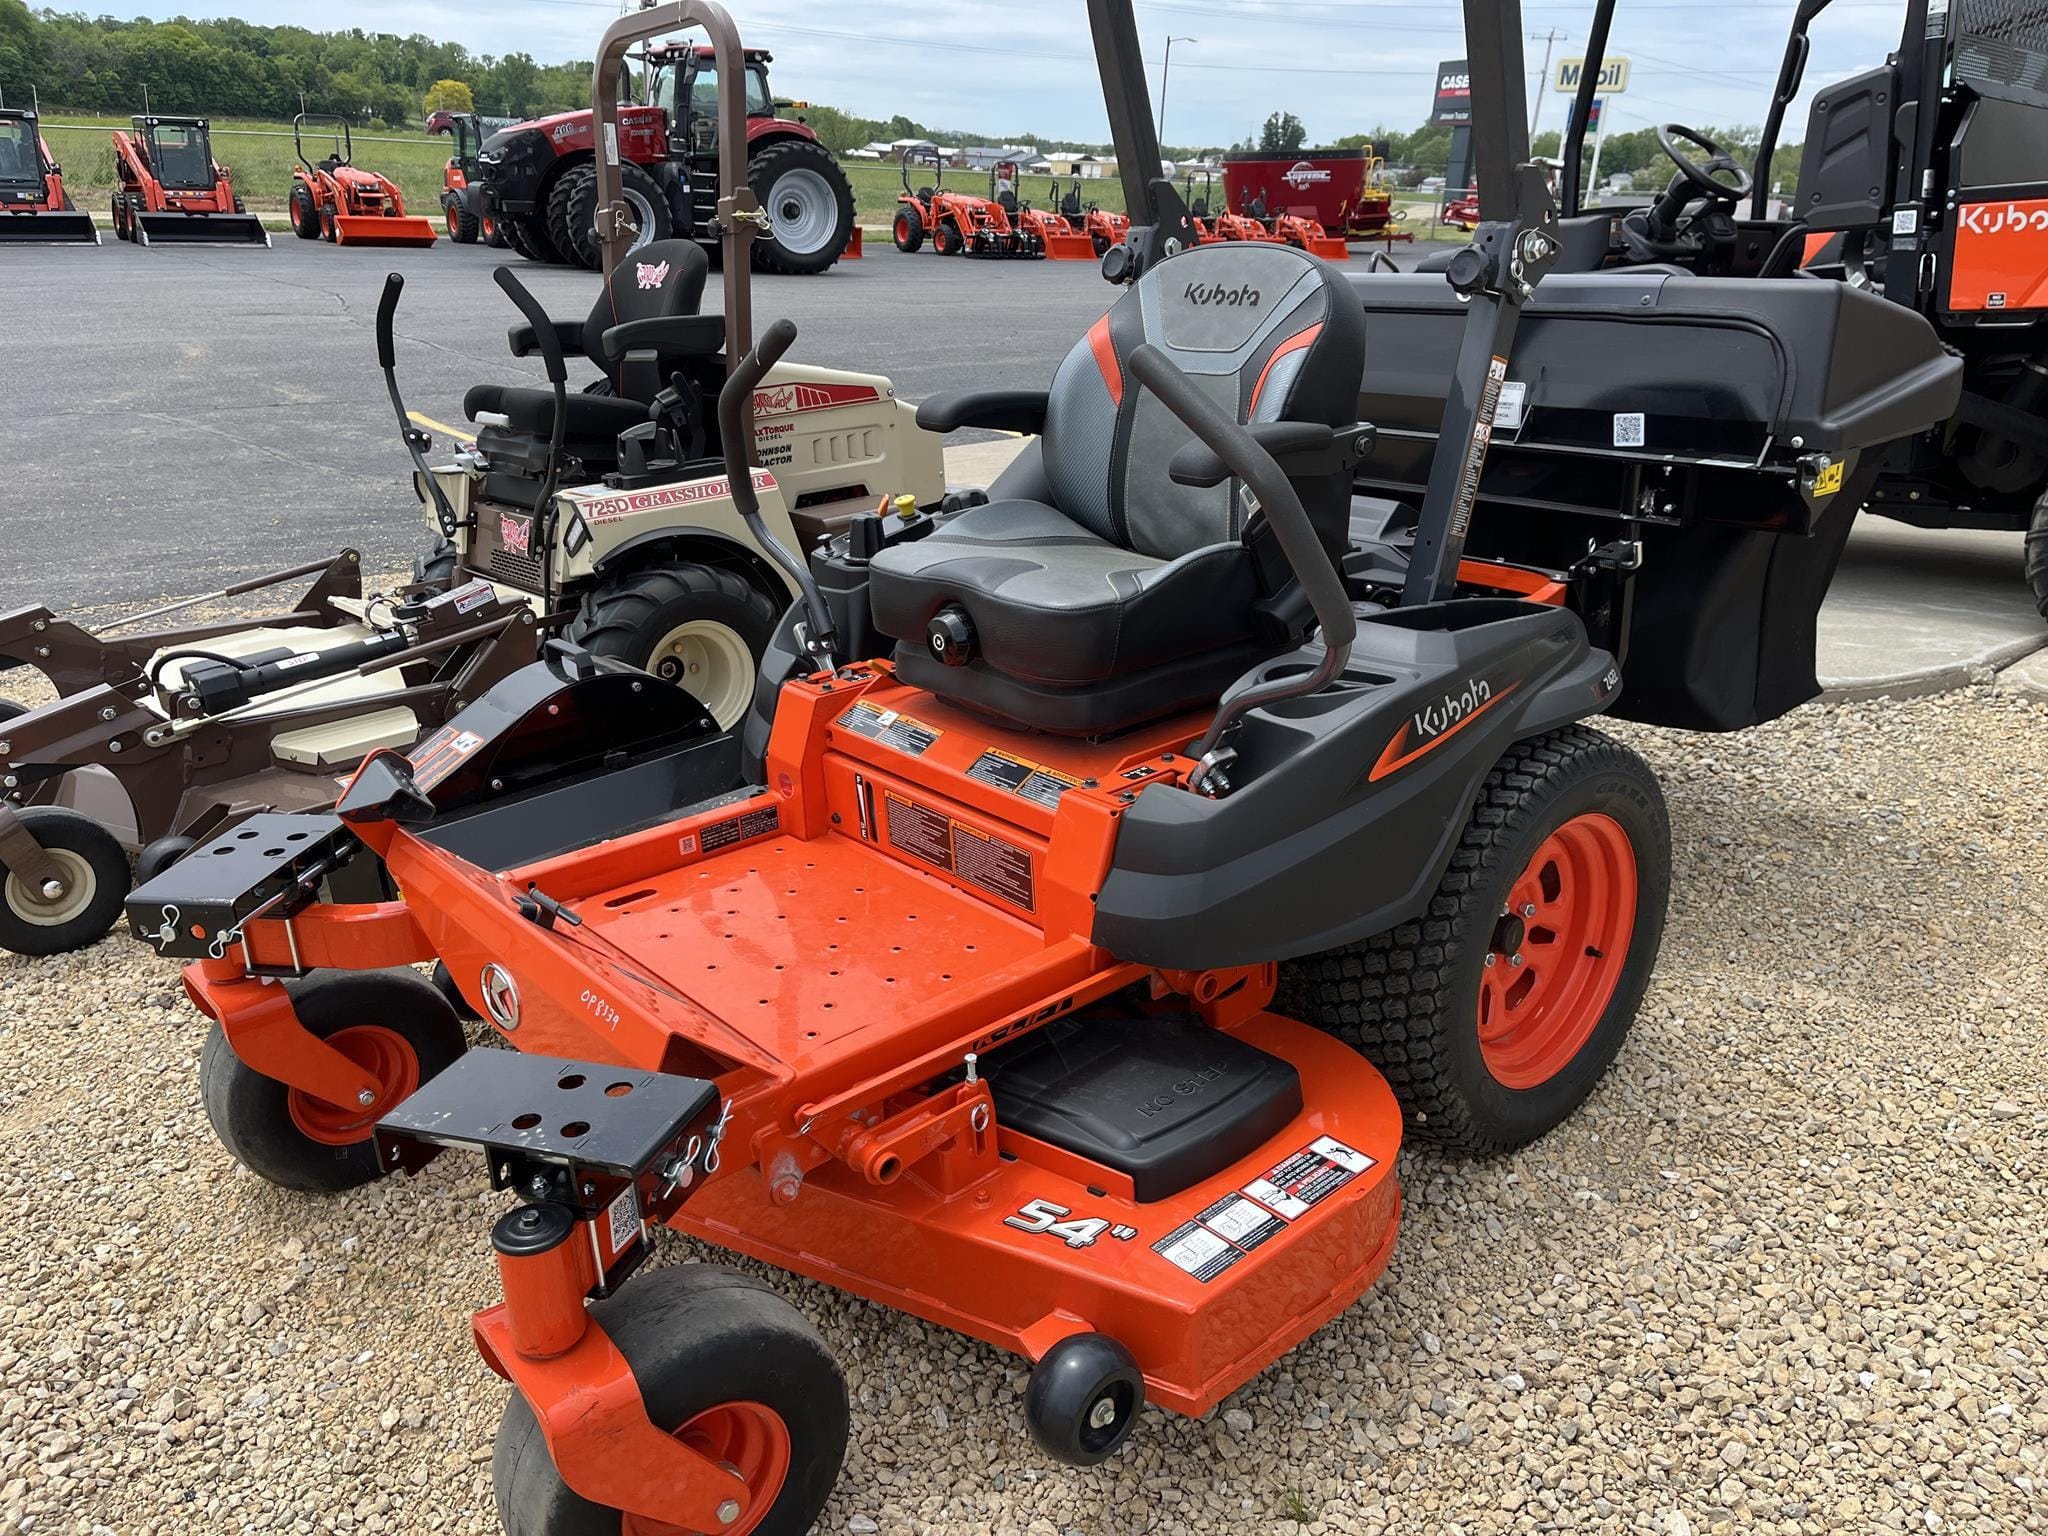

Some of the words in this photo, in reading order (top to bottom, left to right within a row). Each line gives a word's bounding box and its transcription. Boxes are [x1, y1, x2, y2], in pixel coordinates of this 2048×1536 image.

[1560, 65, 1621, 85] Mbil
[1184, 283, 1260, 306] Kubota
[583, 498, 629, 518] 725D
[635, 477, 765, 509] GRASSHOPR
[594, 516, 624, 526] DIESEL
[1414, 678, 1492, 737] Kubota
[1136, 1096, 1174, 1118] NO
[1003, 1198, 1138, 1249] 54"
